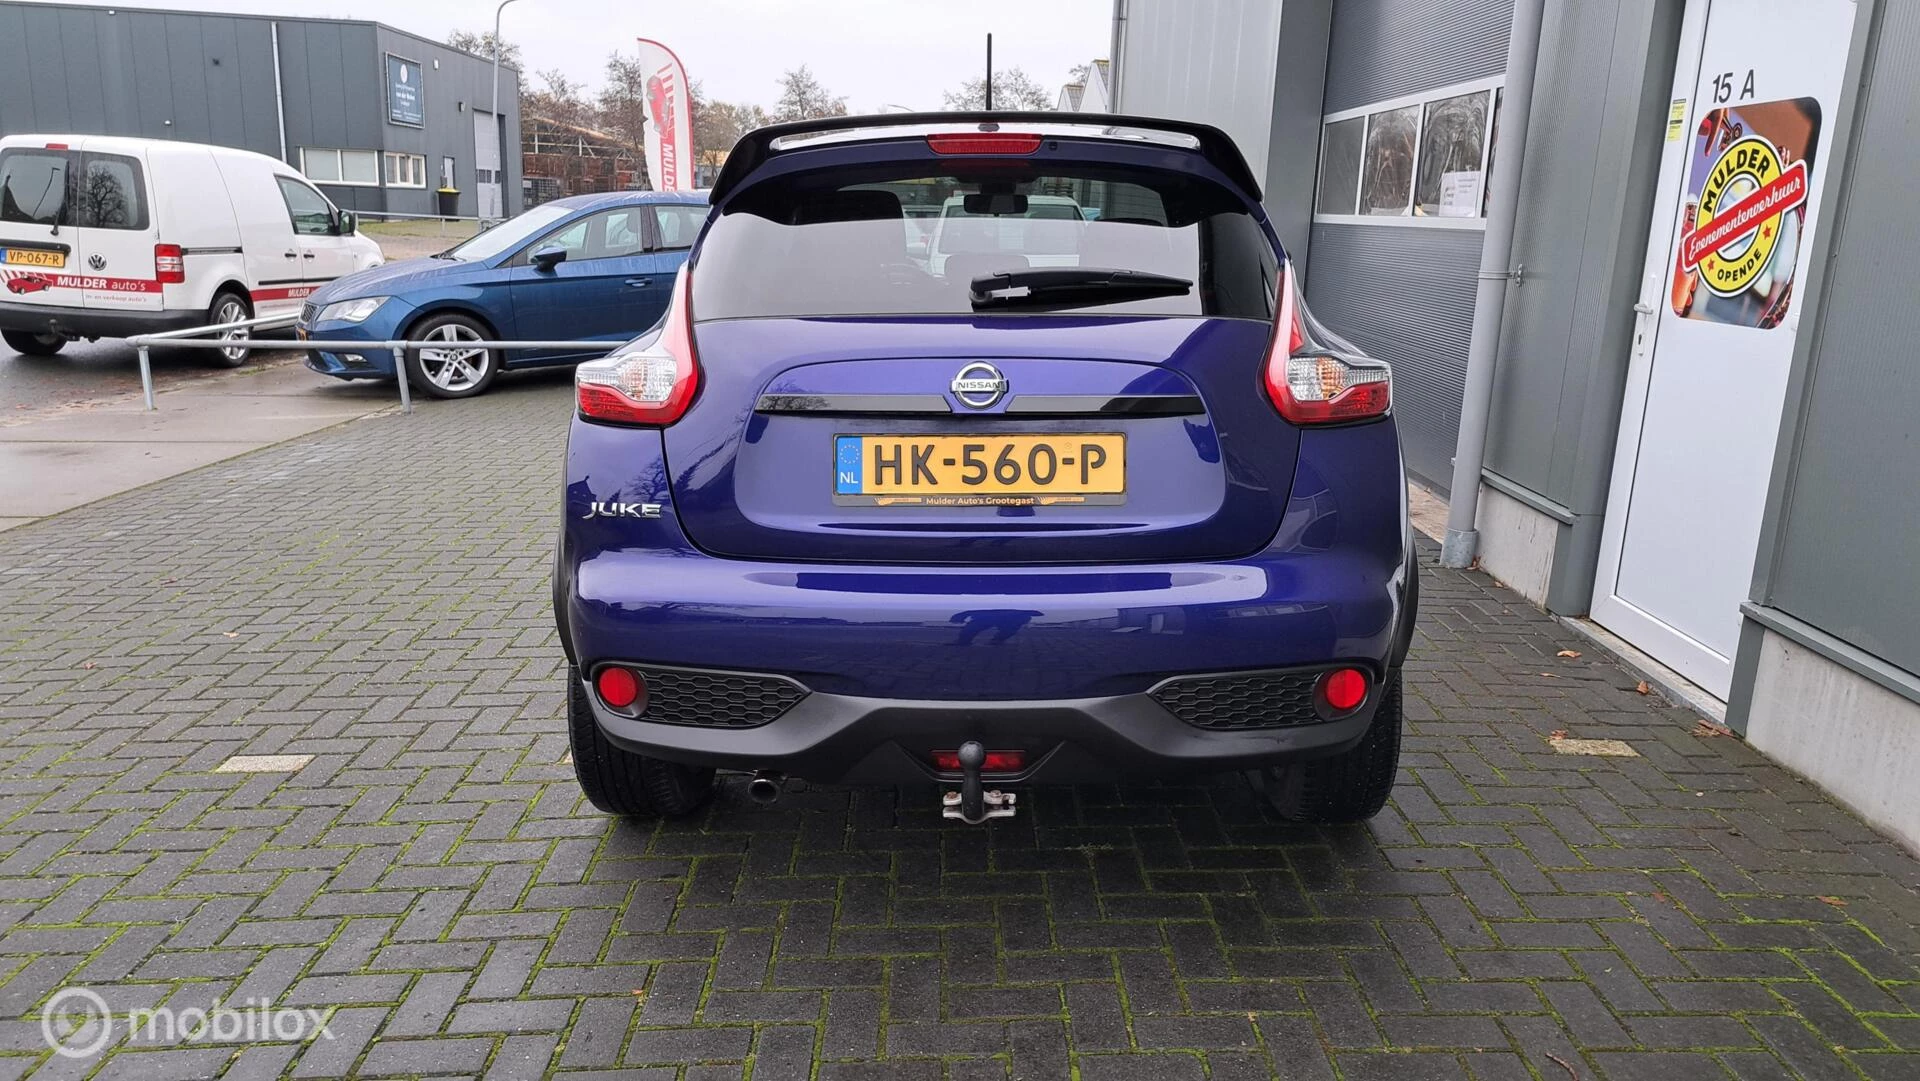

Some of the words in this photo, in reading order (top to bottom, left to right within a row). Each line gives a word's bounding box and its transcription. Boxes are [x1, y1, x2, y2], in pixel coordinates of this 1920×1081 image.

[1712, 72, 1734, 103] 15
[1740, 69, 1756, 100] A
[1702, 148, 1771, 213] MULDER
[1689, 175, 1802, 260] Evenementenverhuur
[8, 250, 60, 265] VP-067-R
[1717, 248, 1762, 282] OPENDE
[57, 275, 107, 289] MULDER
[111, 280, 147, 292] auto's
[957, 381, 1001, 389] NISSAN
[840, 471, 858, 485] NL
[874, 443, 1107, 485] HK-560-P
[582, 502, 662, 519] JUKE
[926, 497, 956, 505] Mulder
[958, 497, 984, 505] Auto's
[985, 497, 1035, 506] Grootegast
